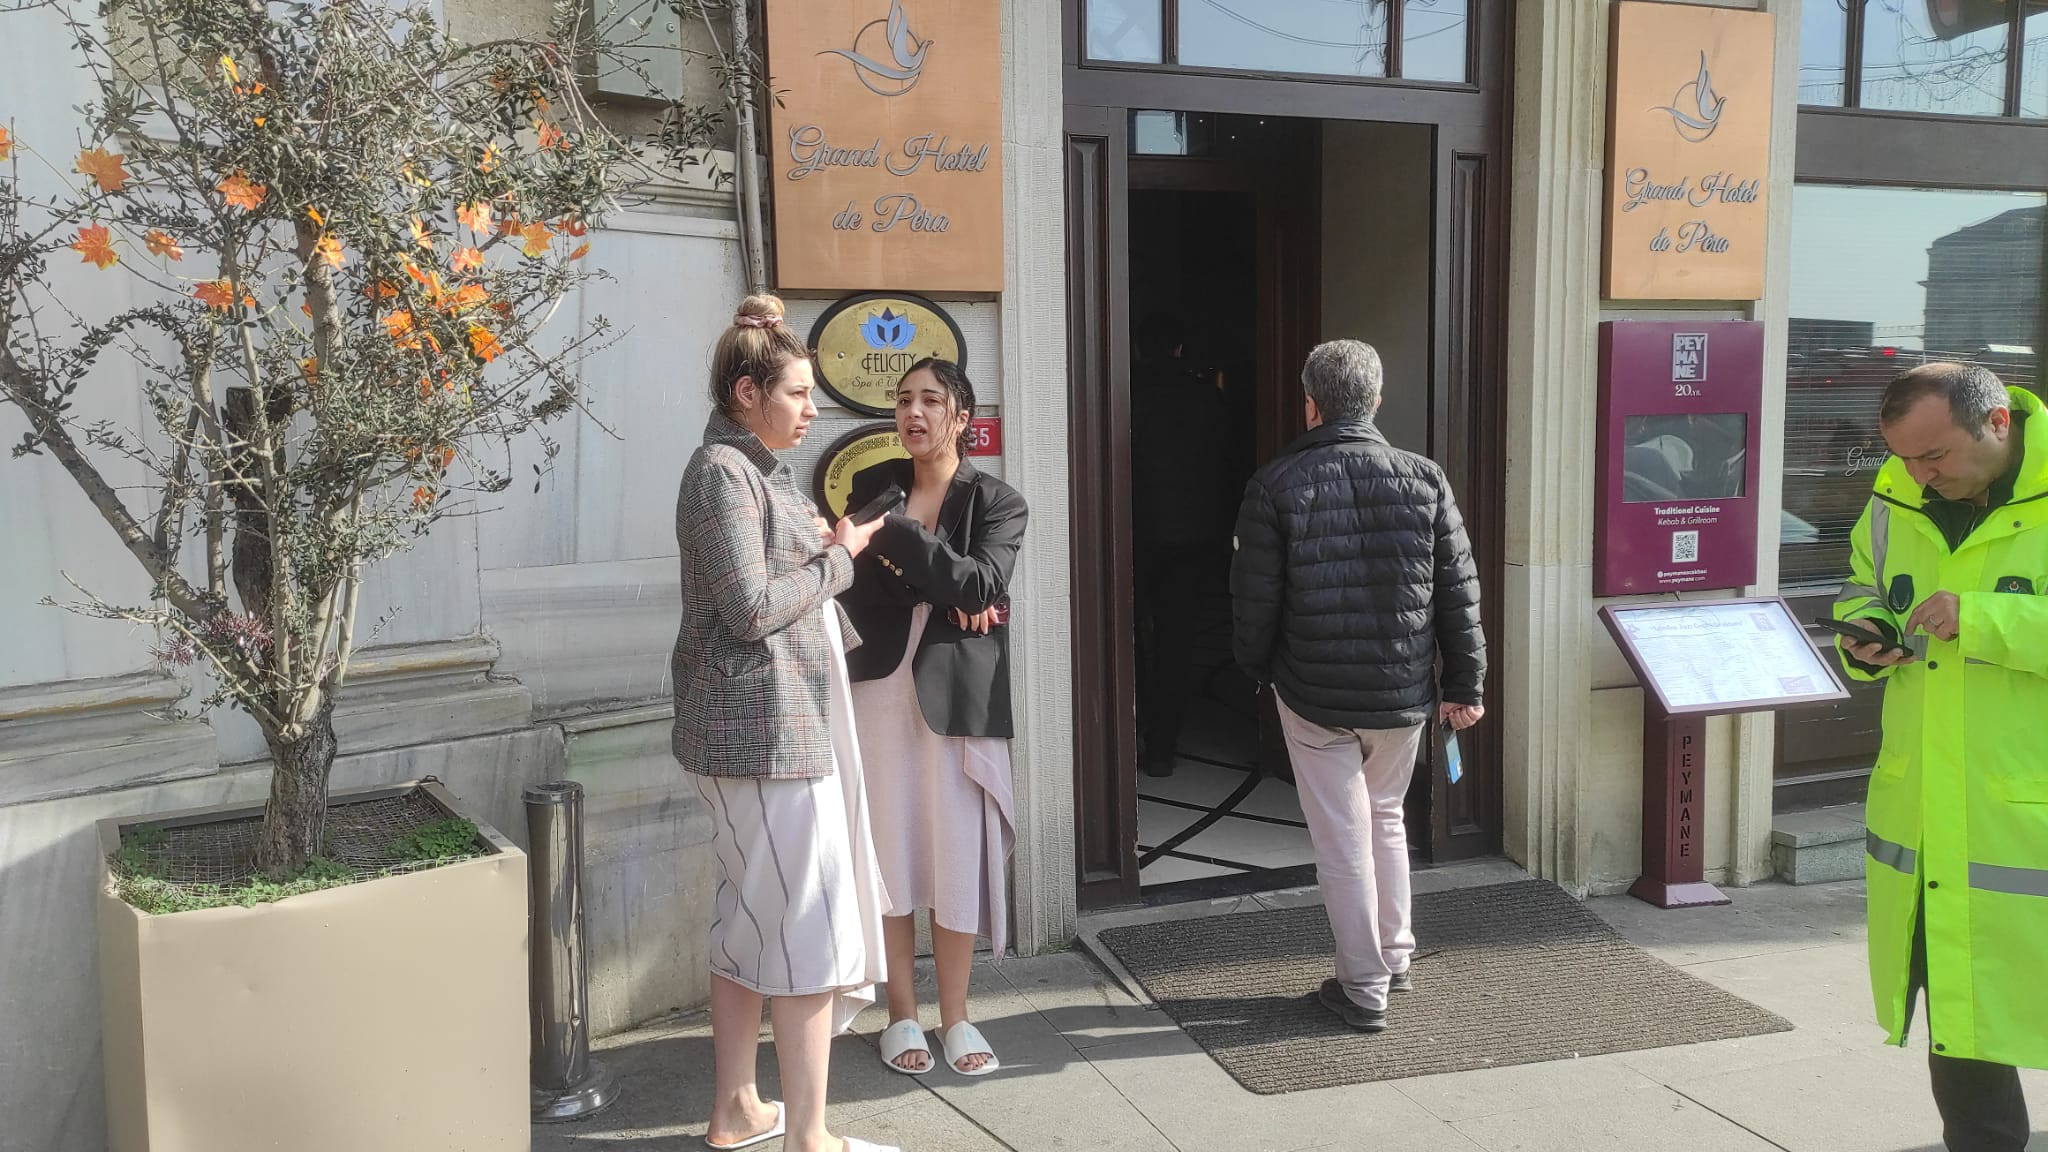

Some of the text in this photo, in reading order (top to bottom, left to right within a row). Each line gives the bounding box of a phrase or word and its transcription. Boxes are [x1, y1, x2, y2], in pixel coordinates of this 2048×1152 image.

[787, 124, 991, 180] Grand Hotel
[1622, 167, 1760, 212] Grand Hotel
[832, 192, 950, 233] de Pera
[1650, 219, 1729, 253] de Pera
[1675, 336, 1705, 351] PEY
[861, 352, 917, 375] FELICITY
[1675, 365, 1697, 379] NE
[852, 375, 873, 390] Spa
[1845, 446, 1888, 477] Grand
[1653, 505, 1721, 515] Traditional Cuisine
[1657, 517, 1680, 526] Kebab
[1687, 516, 1718, 525] Grillroom
[1679, 735, 1693, 858] PEYMANE
